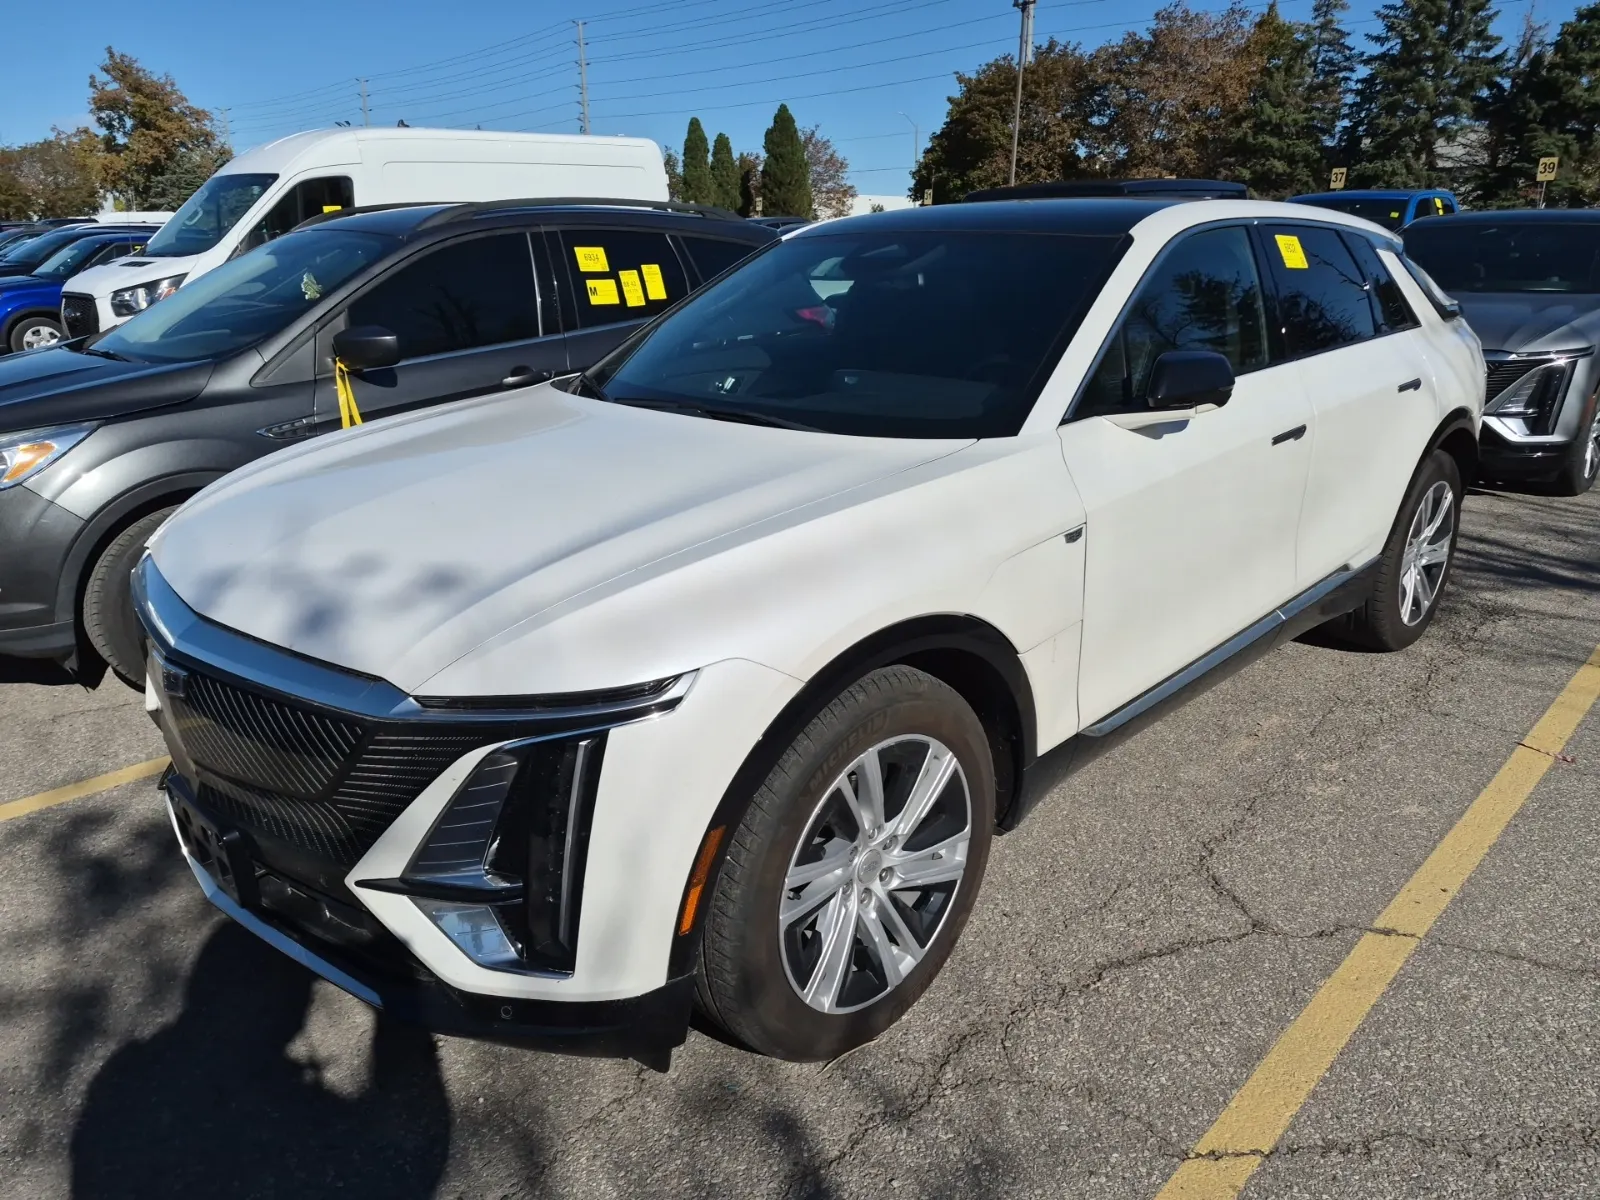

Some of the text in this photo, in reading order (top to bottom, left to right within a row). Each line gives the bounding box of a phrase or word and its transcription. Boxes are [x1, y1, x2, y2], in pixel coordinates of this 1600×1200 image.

[1540, 162, 1556, 174] 39
[1332, 171, 1345, 183] 37
[589, 286, 598, 296] M
[808, 708, 889, 794] MICHELIN
